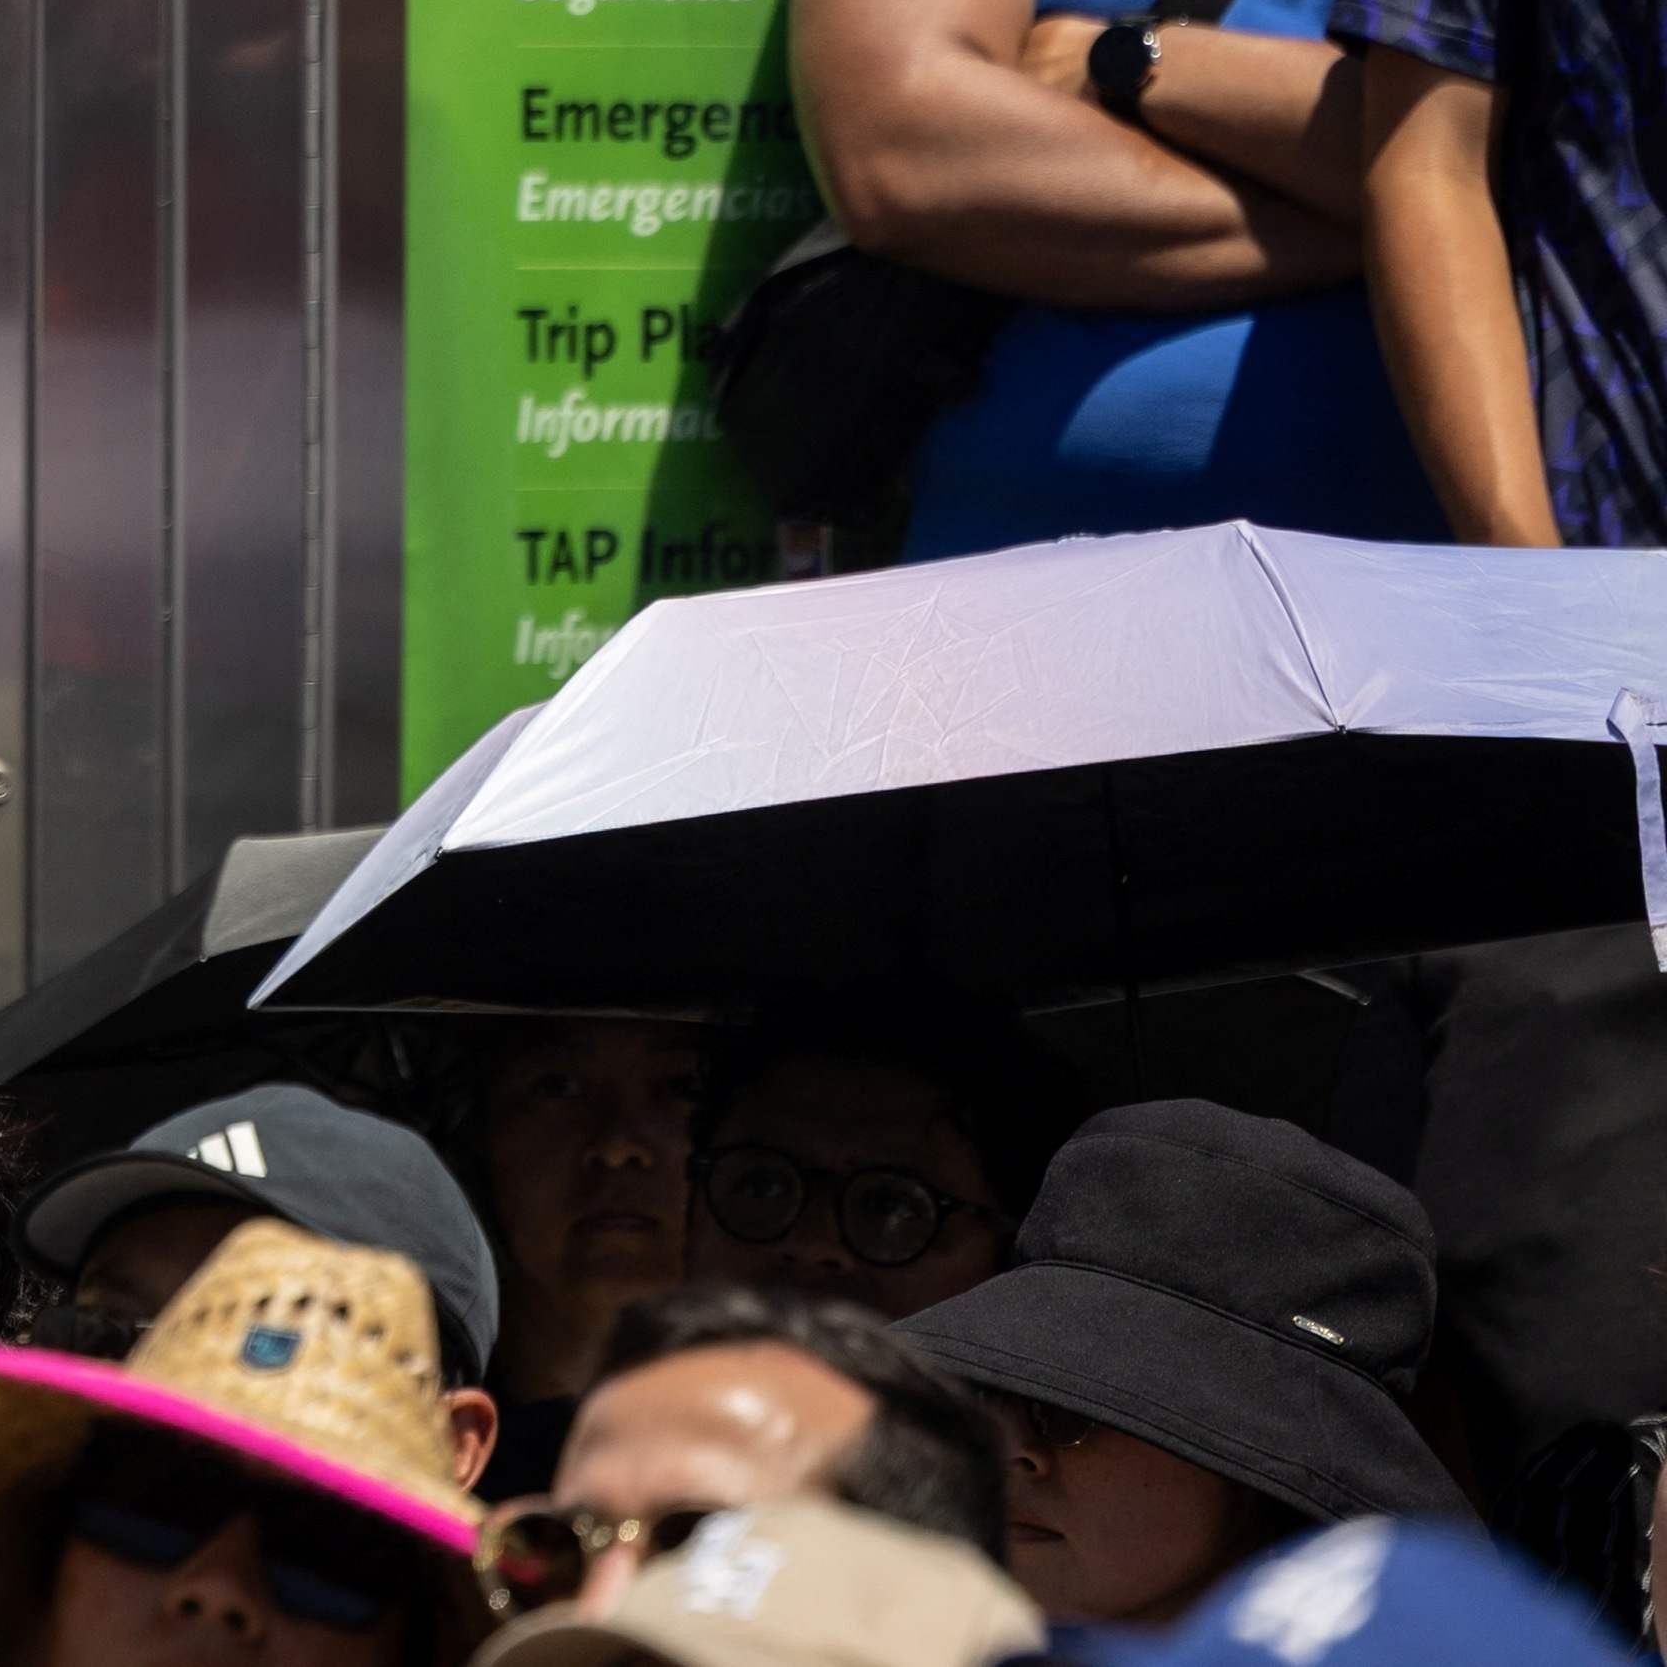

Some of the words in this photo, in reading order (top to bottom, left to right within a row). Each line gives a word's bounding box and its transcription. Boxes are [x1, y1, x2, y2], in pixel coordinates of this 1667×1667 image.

[521, 88, 801, 160] Emergenc
[517, 304, 617, 384] Trip
[517, 393, 722, 459] Informac
[516, 529, 619, 586] TAP
[641, 522, 777, 584] Infor
[515, 608, 617, 679] Info
